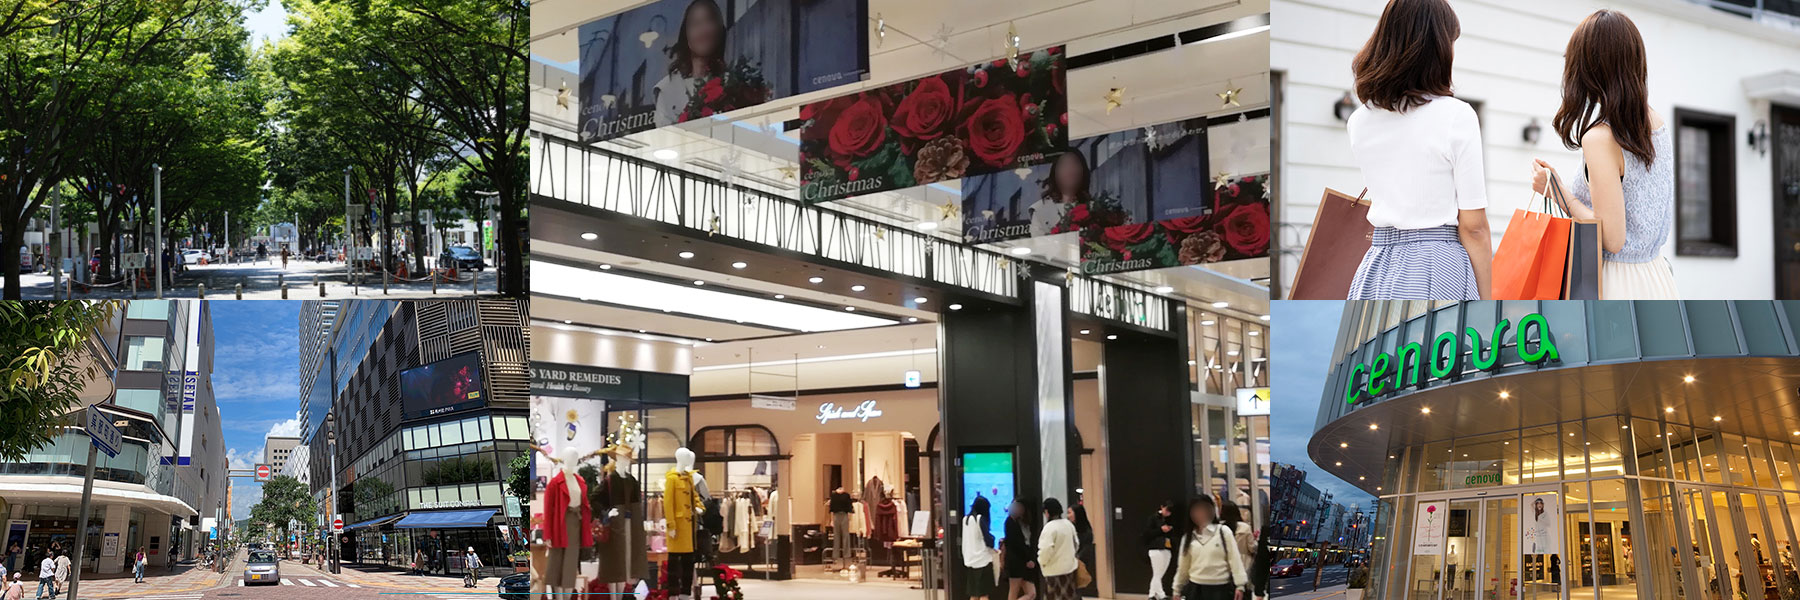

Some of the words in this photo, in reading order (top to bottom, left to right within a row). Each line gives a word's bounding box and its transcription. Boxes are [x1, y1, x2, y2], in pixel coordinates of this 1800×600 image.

[813, 72, 843, 85] cenova
[583, 110, 656, 140] Christma
[1017, 152, 1044, 163] cenova
[804, 176, 882, 200] Christmas
[967, 223, 1032, 242] Christma
[1084, 258, 1152, 274] Christmas
[1347, 313, 1559, 404] cenova
[540, 369, 567, 381] YARD
[569, 372, 621, 385] REMEDIES
[184, 370, 200, 411] ISETAN
[1465, 472, 1501, 485] cenova
